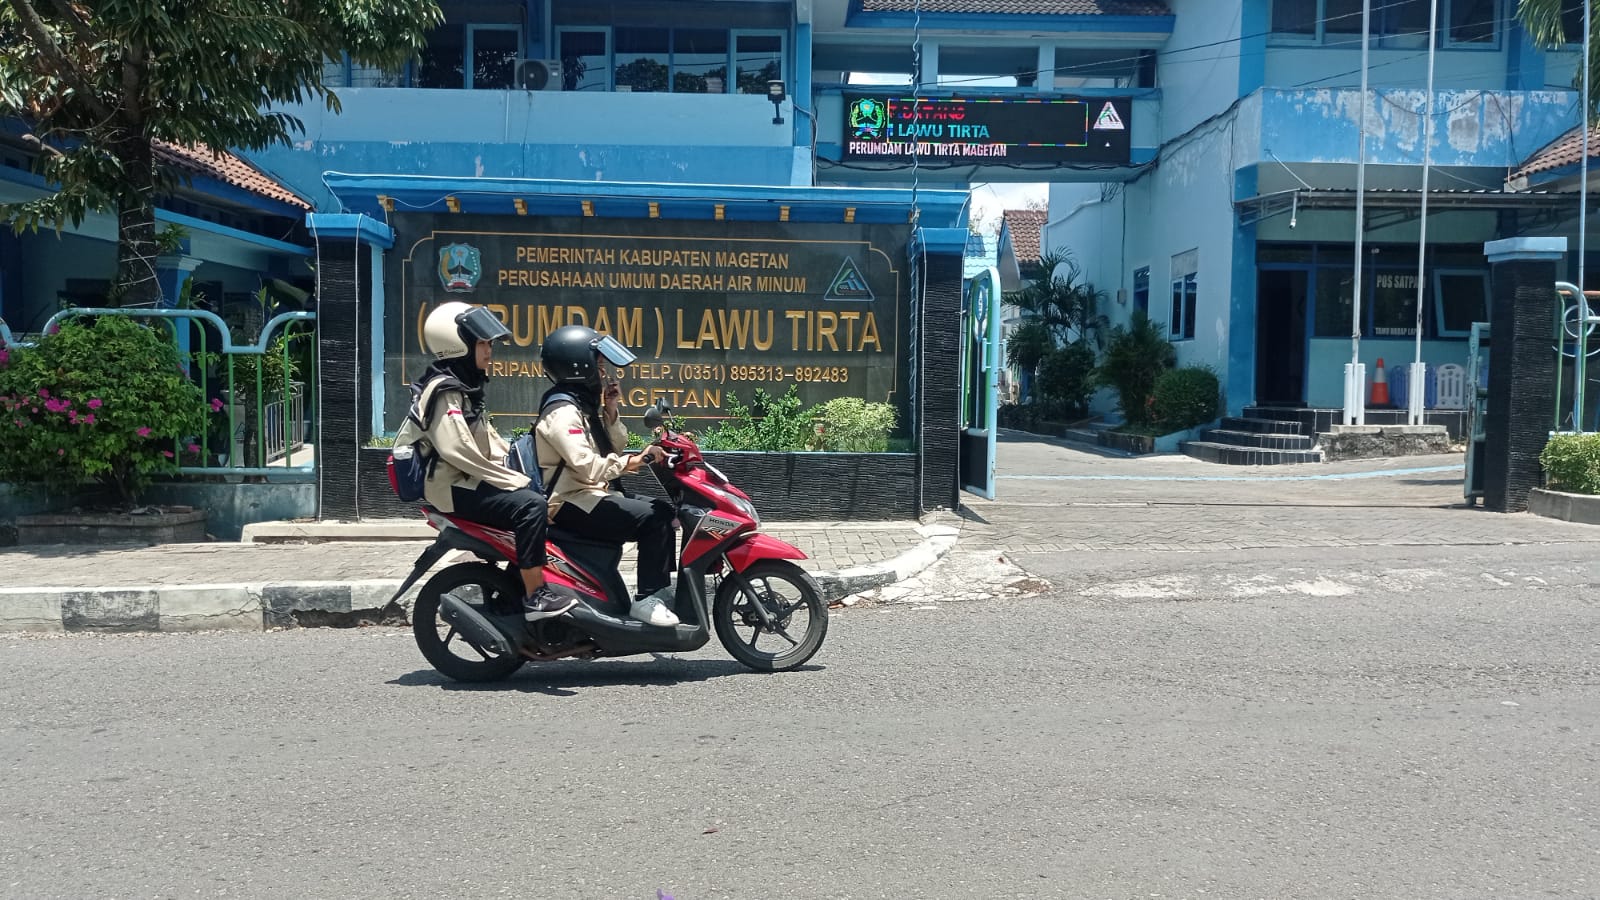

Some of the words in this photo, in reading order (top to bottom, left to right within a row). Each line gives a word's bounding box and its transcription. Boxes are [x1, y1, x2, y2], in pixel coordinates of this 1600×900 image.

[898, 122, 943, 138] LAWU
[947, 124, 990, 138] TIRTA
[849, 142, 901, 155] PERUMDAM
[904, 142, 931, 156] LAWU
[933, 143, 960, 156] TIRTA
[962, 143, 1007, 157] MAGETAN
[516, 246, 615, 265] PEMERINTAH
[619, 249, 711, 267] KABUPATEN
[715, 251, 789, 270] MAGETAN
[498, 269, 605, 287] PERUSAHAAN
[609, 272, 656, 289] UMUM
[660, 273, 723, 291] DAERAH
[727, 275, 752, 292] AIR
[756, 276, 807, 294] MINUM
[1376, 274, 1393, 288] POS
[676, 308, 775, 351] LAWU
[785, 310, 882, 353] TIRTA
[629, 363, 674, 381] TELP.
[678, 364, 726, 385] (0351)
[730, 364, 849, 383] 895313-892483
[709, 517, 735, 528] HONDA
